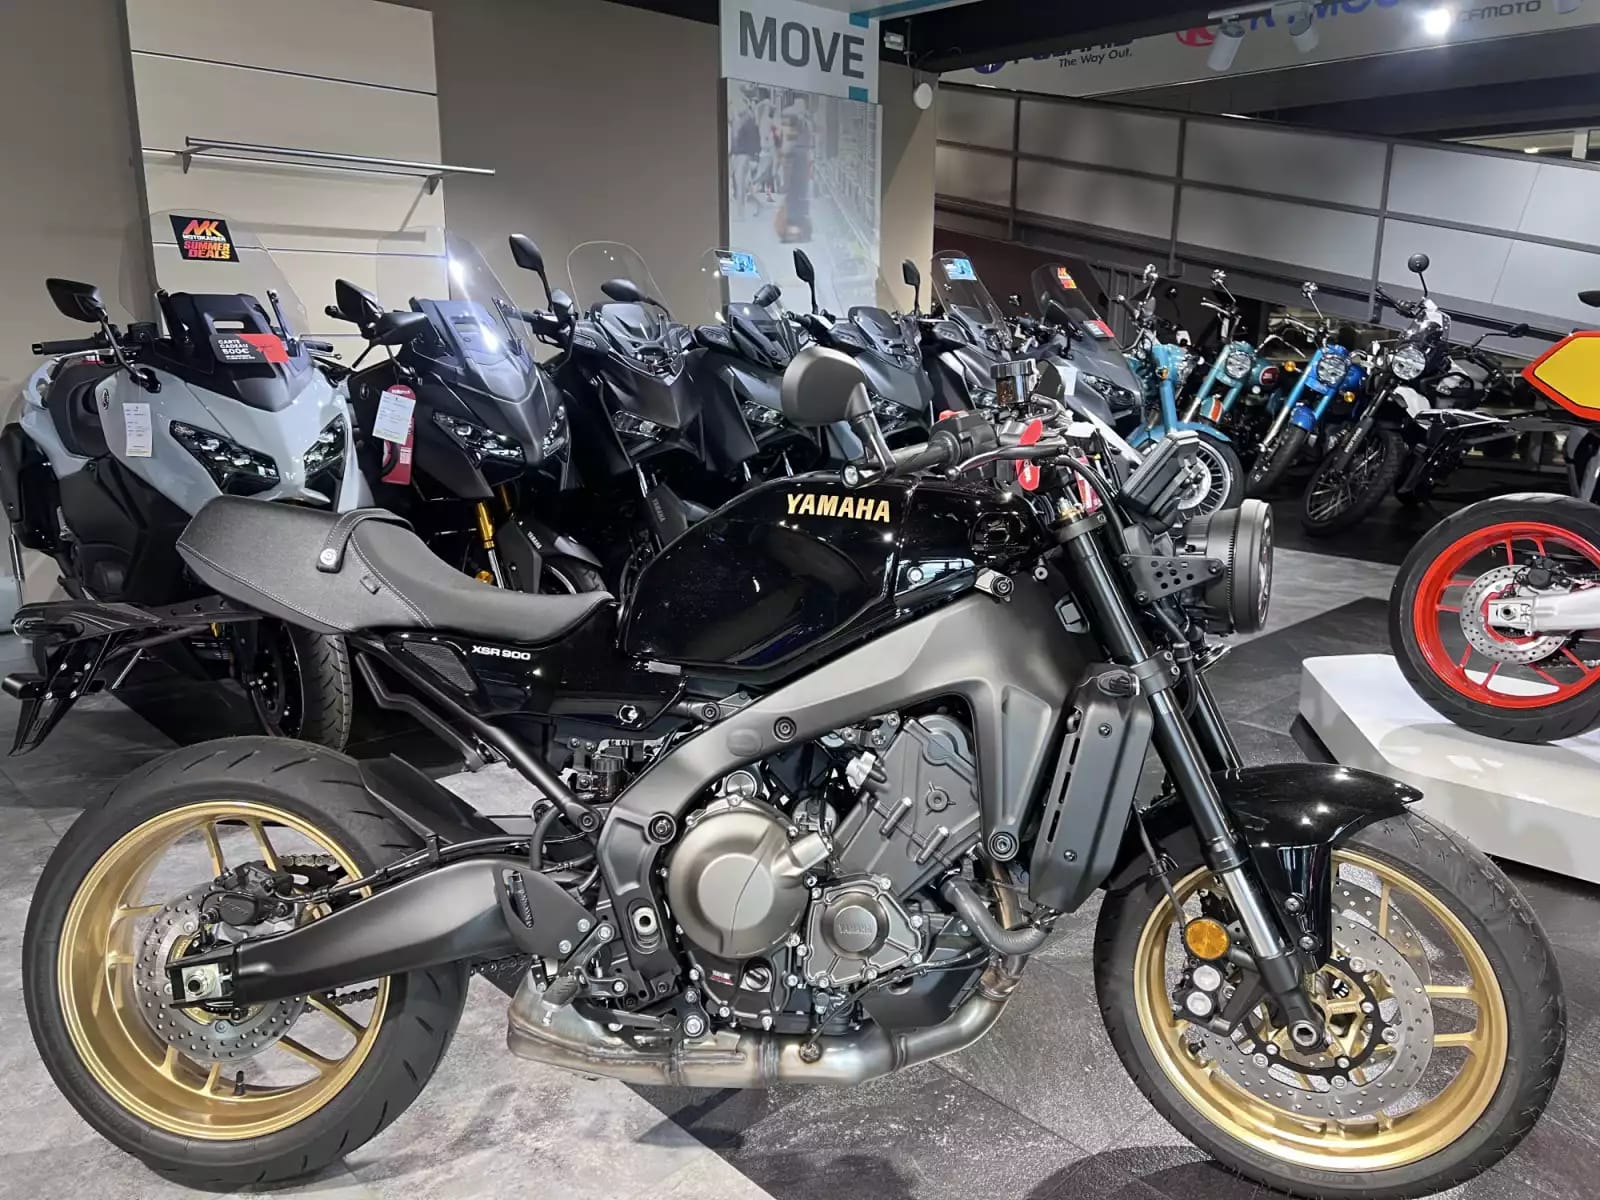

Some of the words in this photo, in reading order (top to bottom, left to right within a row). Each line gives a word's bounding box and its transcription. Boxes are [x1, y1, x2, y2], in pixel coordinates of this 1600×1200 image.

[739, 10, 865, 79] MOVE
[1058, 57, 1078, 68] The
[1080, 52, 1104, 65] Way
[184, 240, 230, 252] SUMMER
[188, 249, 231, 259] DEALS
[787, 493, 891, 523] YAMAHA
[471, 645, 501, 657] XSR
[501, 649, 531, 661] 900
